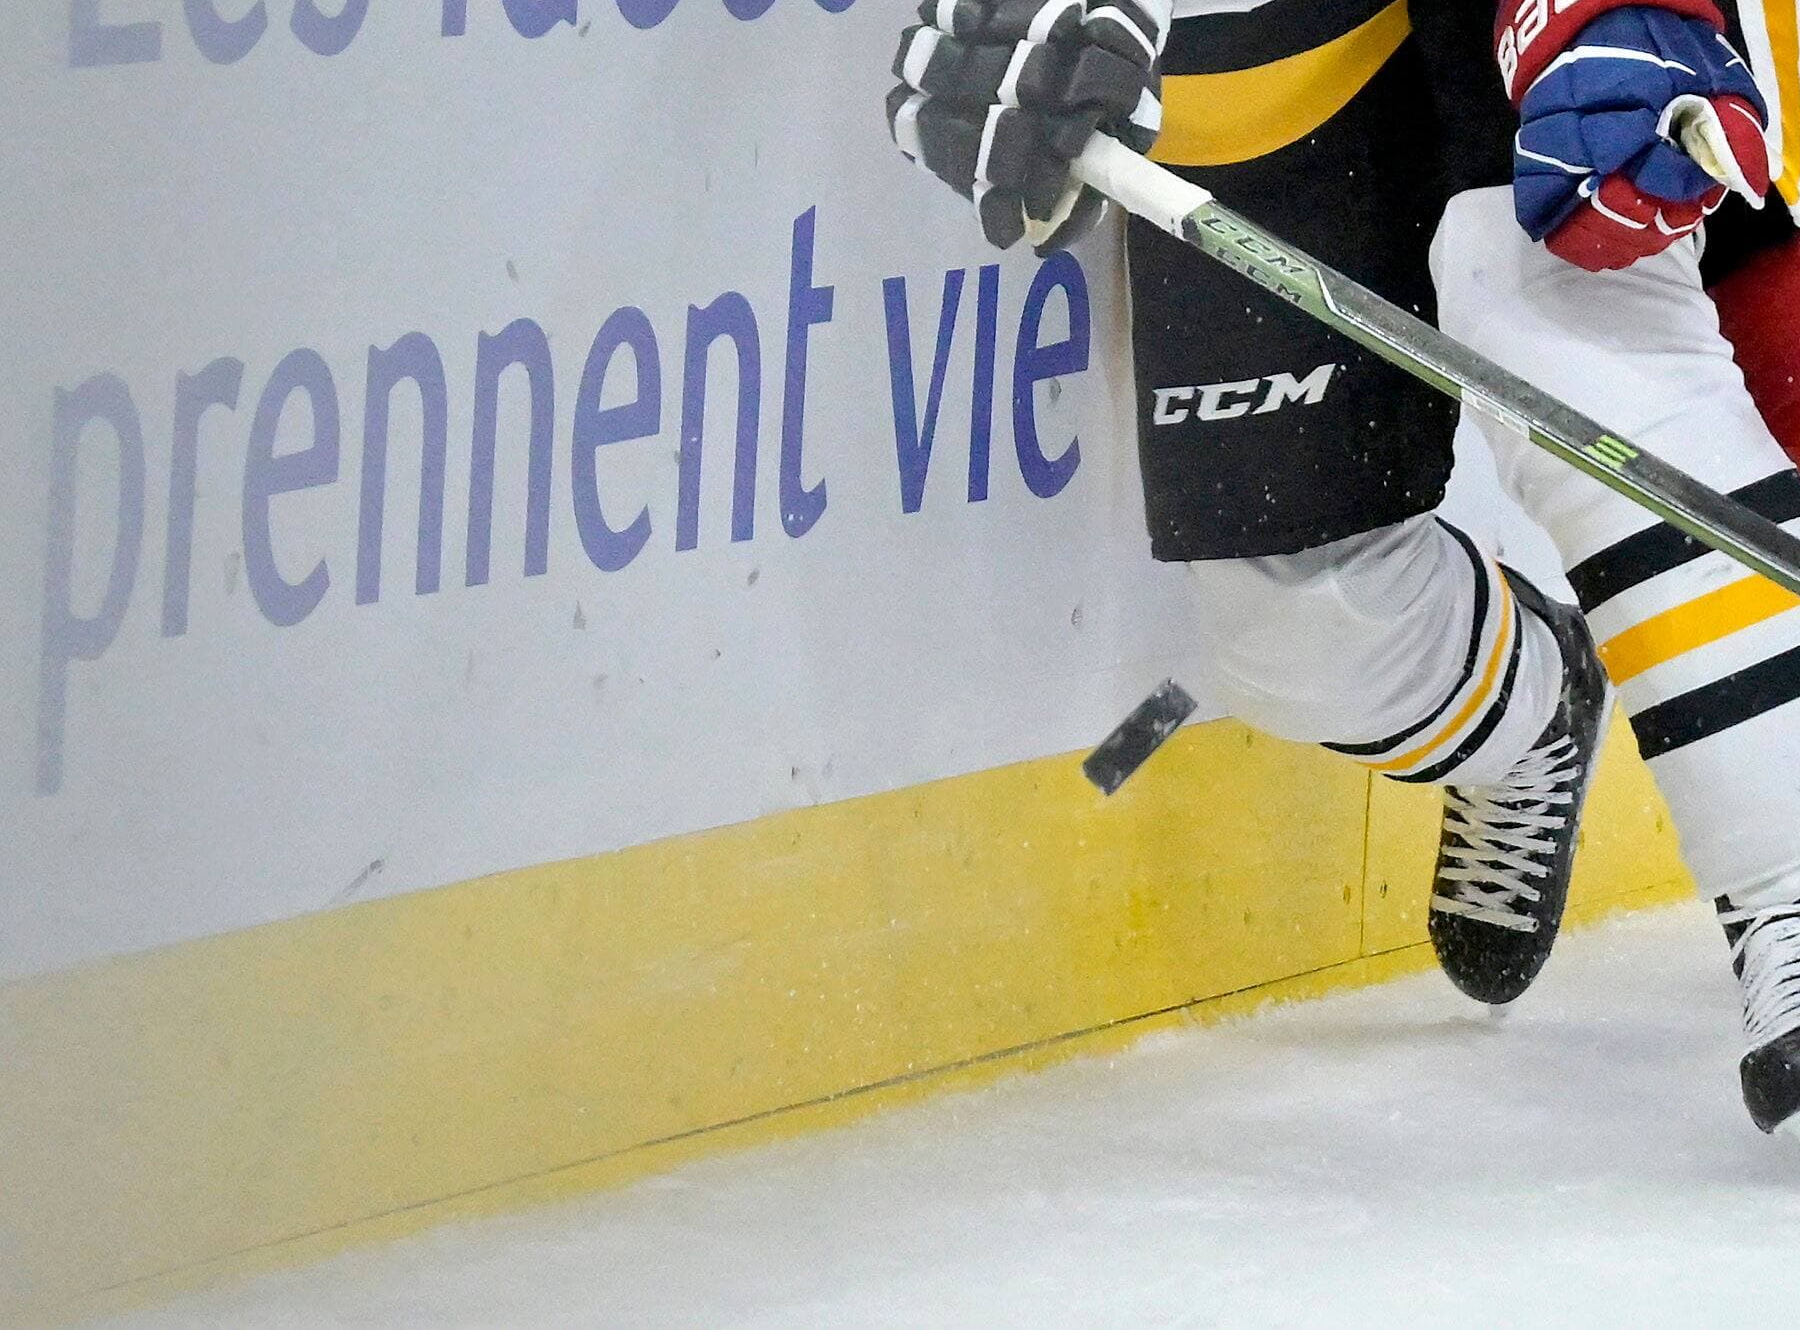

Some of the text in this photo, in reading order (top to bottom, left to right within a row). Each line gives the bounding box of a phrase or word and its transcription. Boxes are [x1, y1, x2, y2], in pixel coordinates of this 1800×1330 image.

[1200, 216, 1306, 274] CCM
[1217, 247, 1302, 303] CCM
[1153, 364, 1337, 425] CCM
[33, 204, 1093, 798] prennent vie
